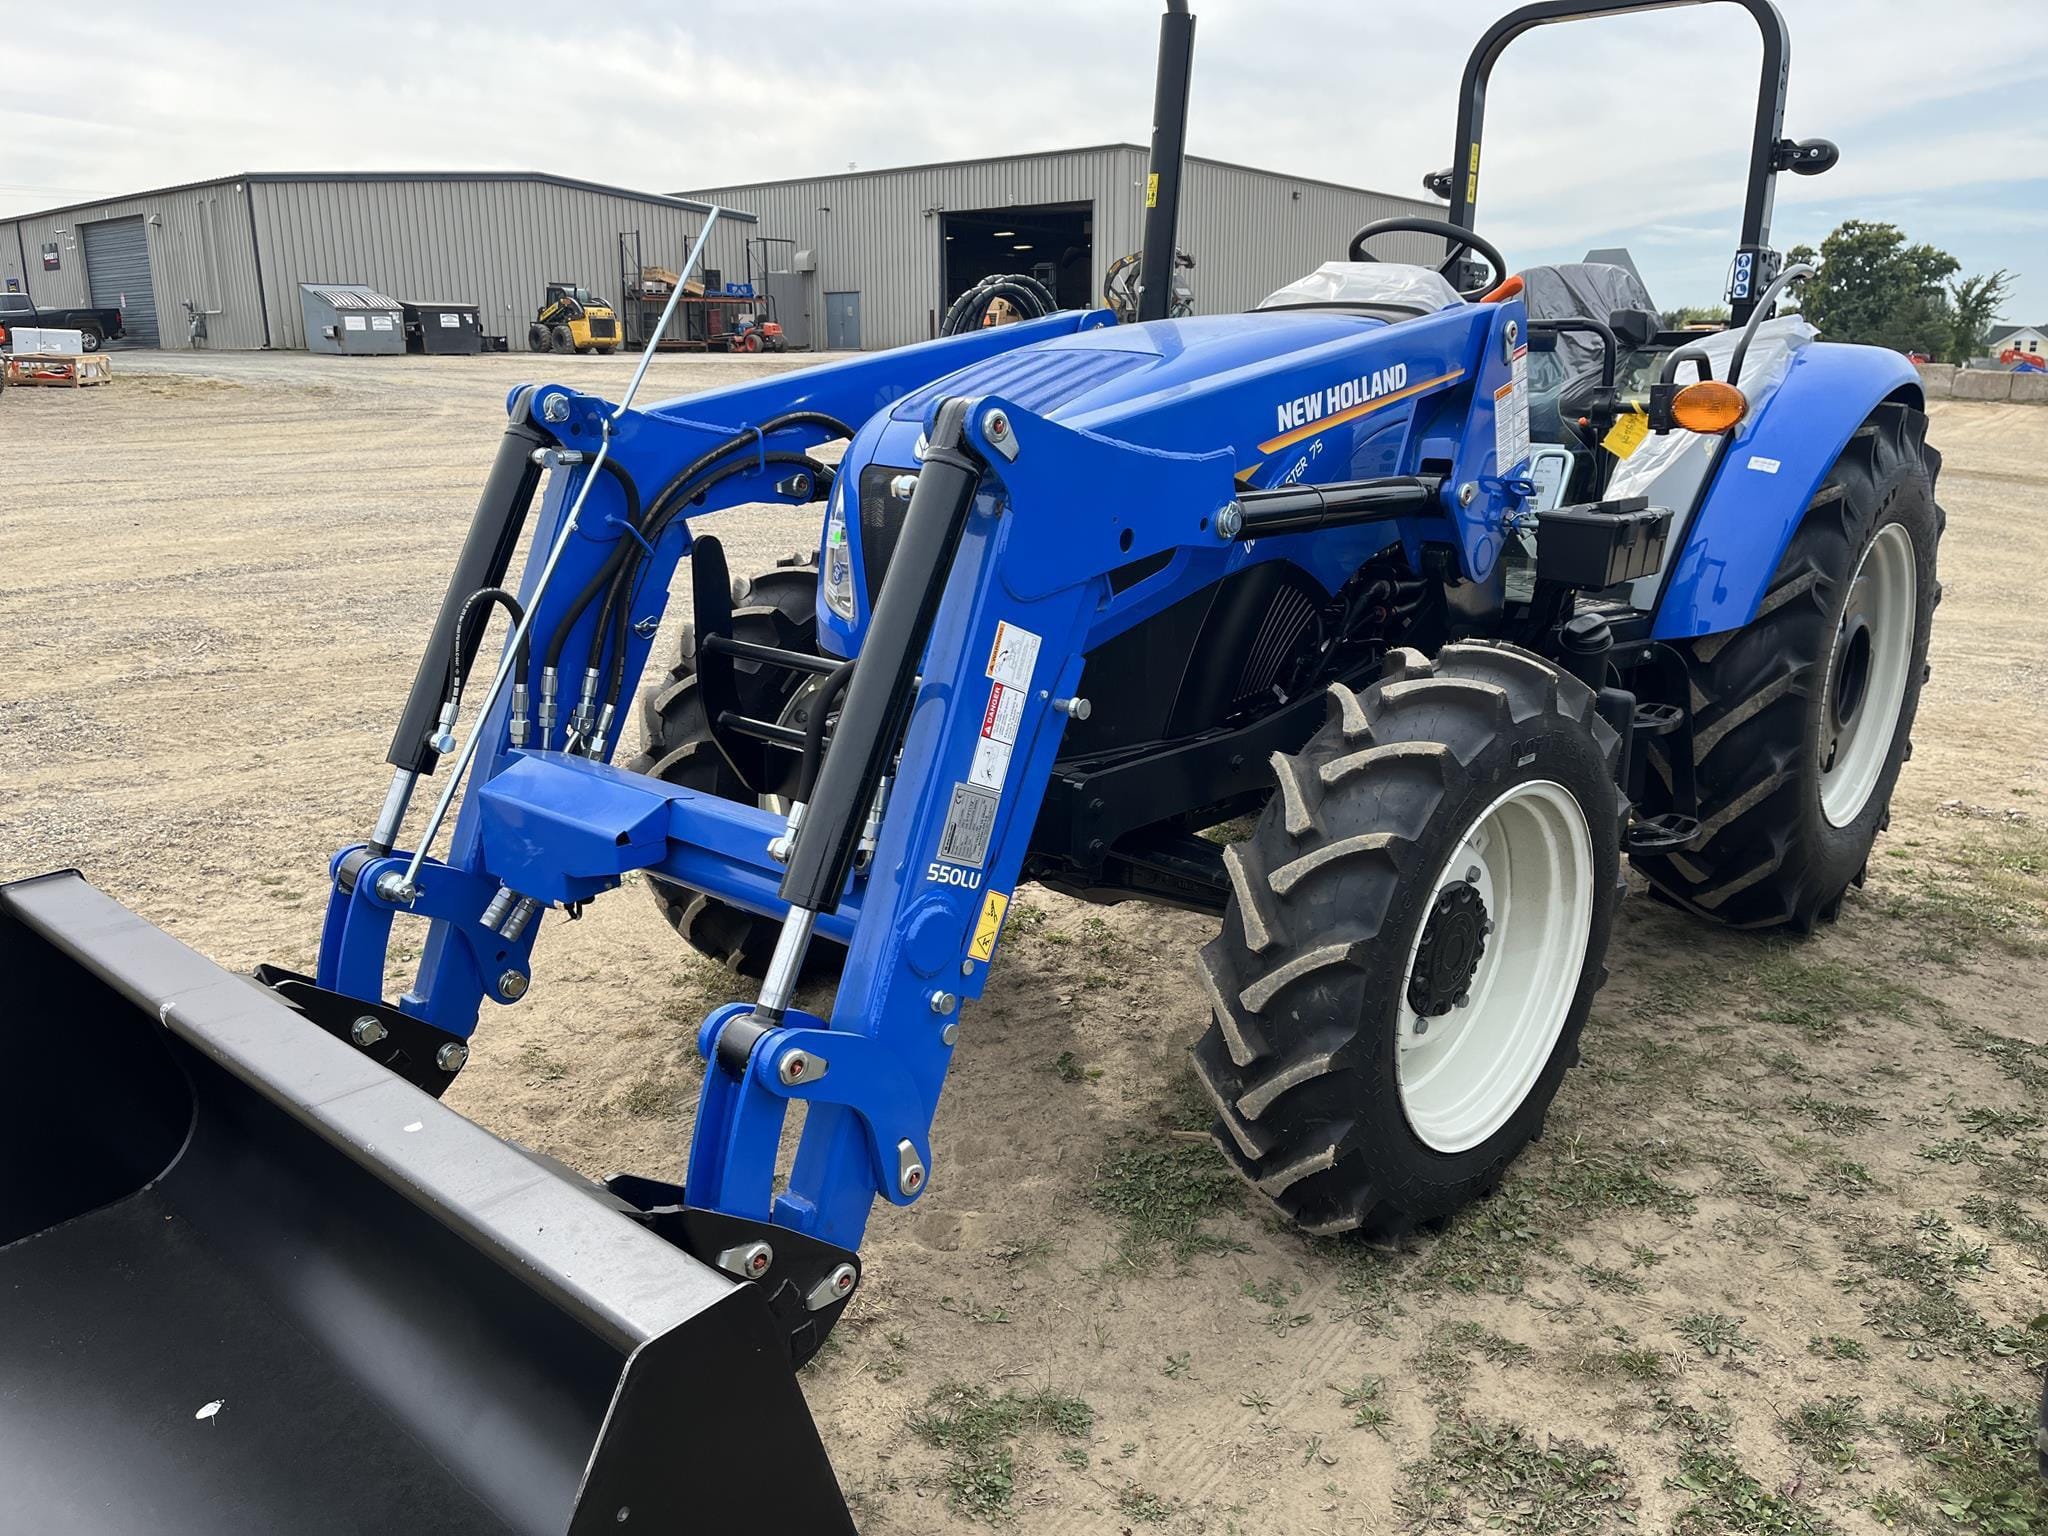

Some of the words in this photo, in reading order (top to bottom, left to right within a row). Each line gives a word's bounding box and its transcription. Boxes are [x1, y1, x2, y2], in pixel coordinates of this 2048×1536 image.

[1277, 391, 1323, 433] NEW
[1326, 362, 1408, 415] HOLLAND
[1308, 438, 1324, 460] 75
[992, 626, 1005, 662] WARNING
[987, 686, 1001, 724] DANGER
[926, 862, 982, 890] 550LU
